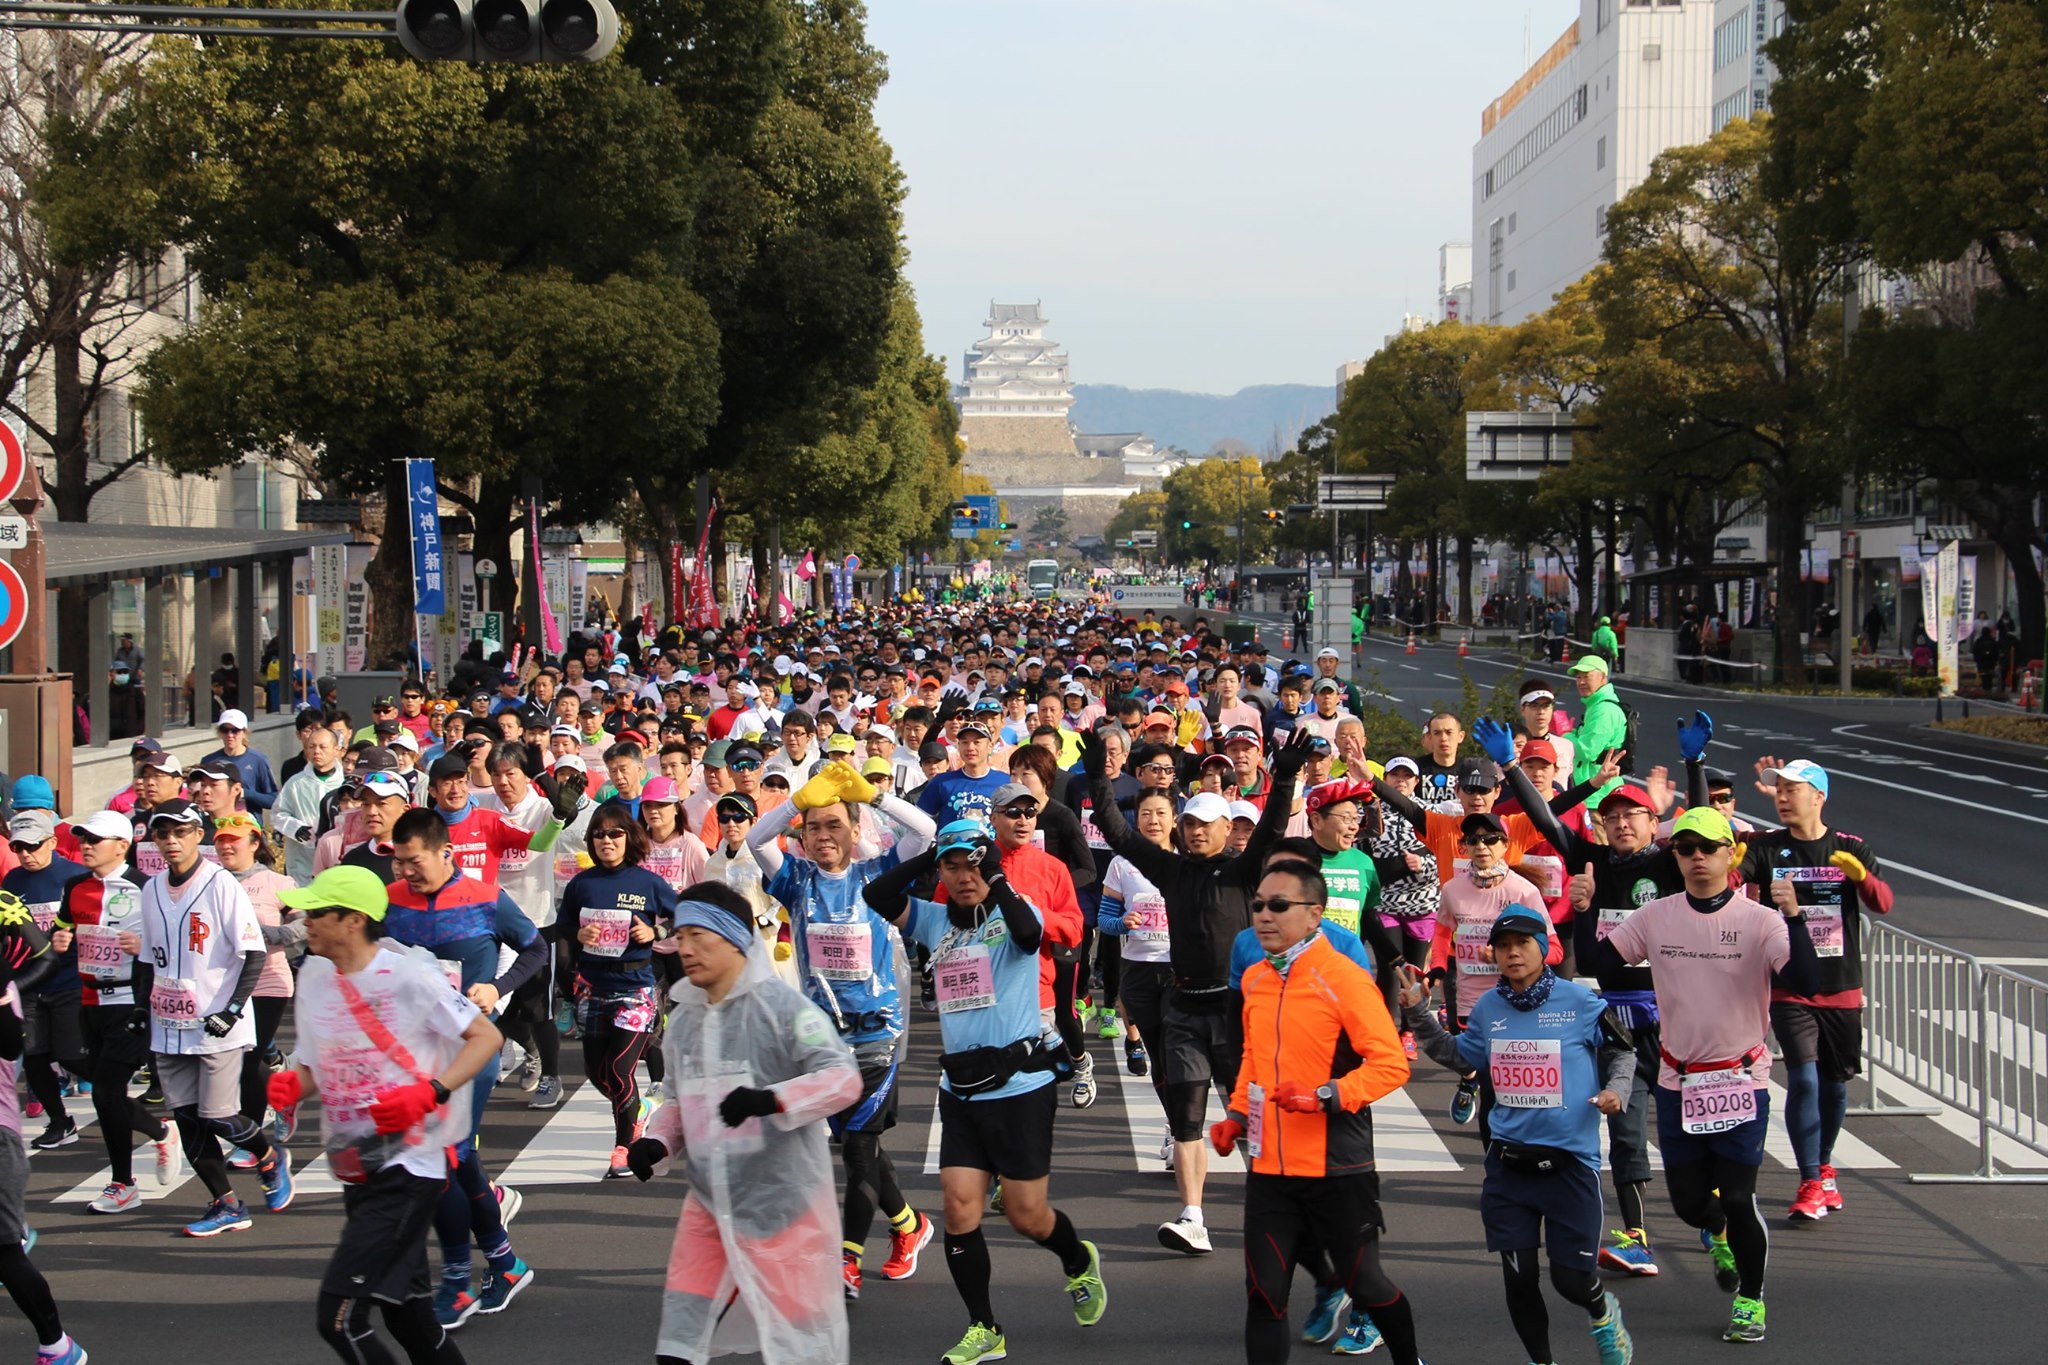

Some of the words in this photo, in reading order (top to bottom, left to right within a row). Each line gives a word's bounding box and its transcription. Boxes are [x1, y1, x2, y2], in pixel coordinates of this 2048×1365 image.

[420, 512, 441, 592] 神戸新聞
[462, 852, 486, 866] 2018
[501, 847, 528, 859] 190
[1812, 868, 1843, 879] Magic
[618, 892, 646, 905] KLPRC
[79, 943, 120, 961] D15295
[1492, 1066, 1558, 1088] D35030
[1684, 1092, 1752, 1118] D30208
[1691, 1116, 1748, 1133] GLORY
